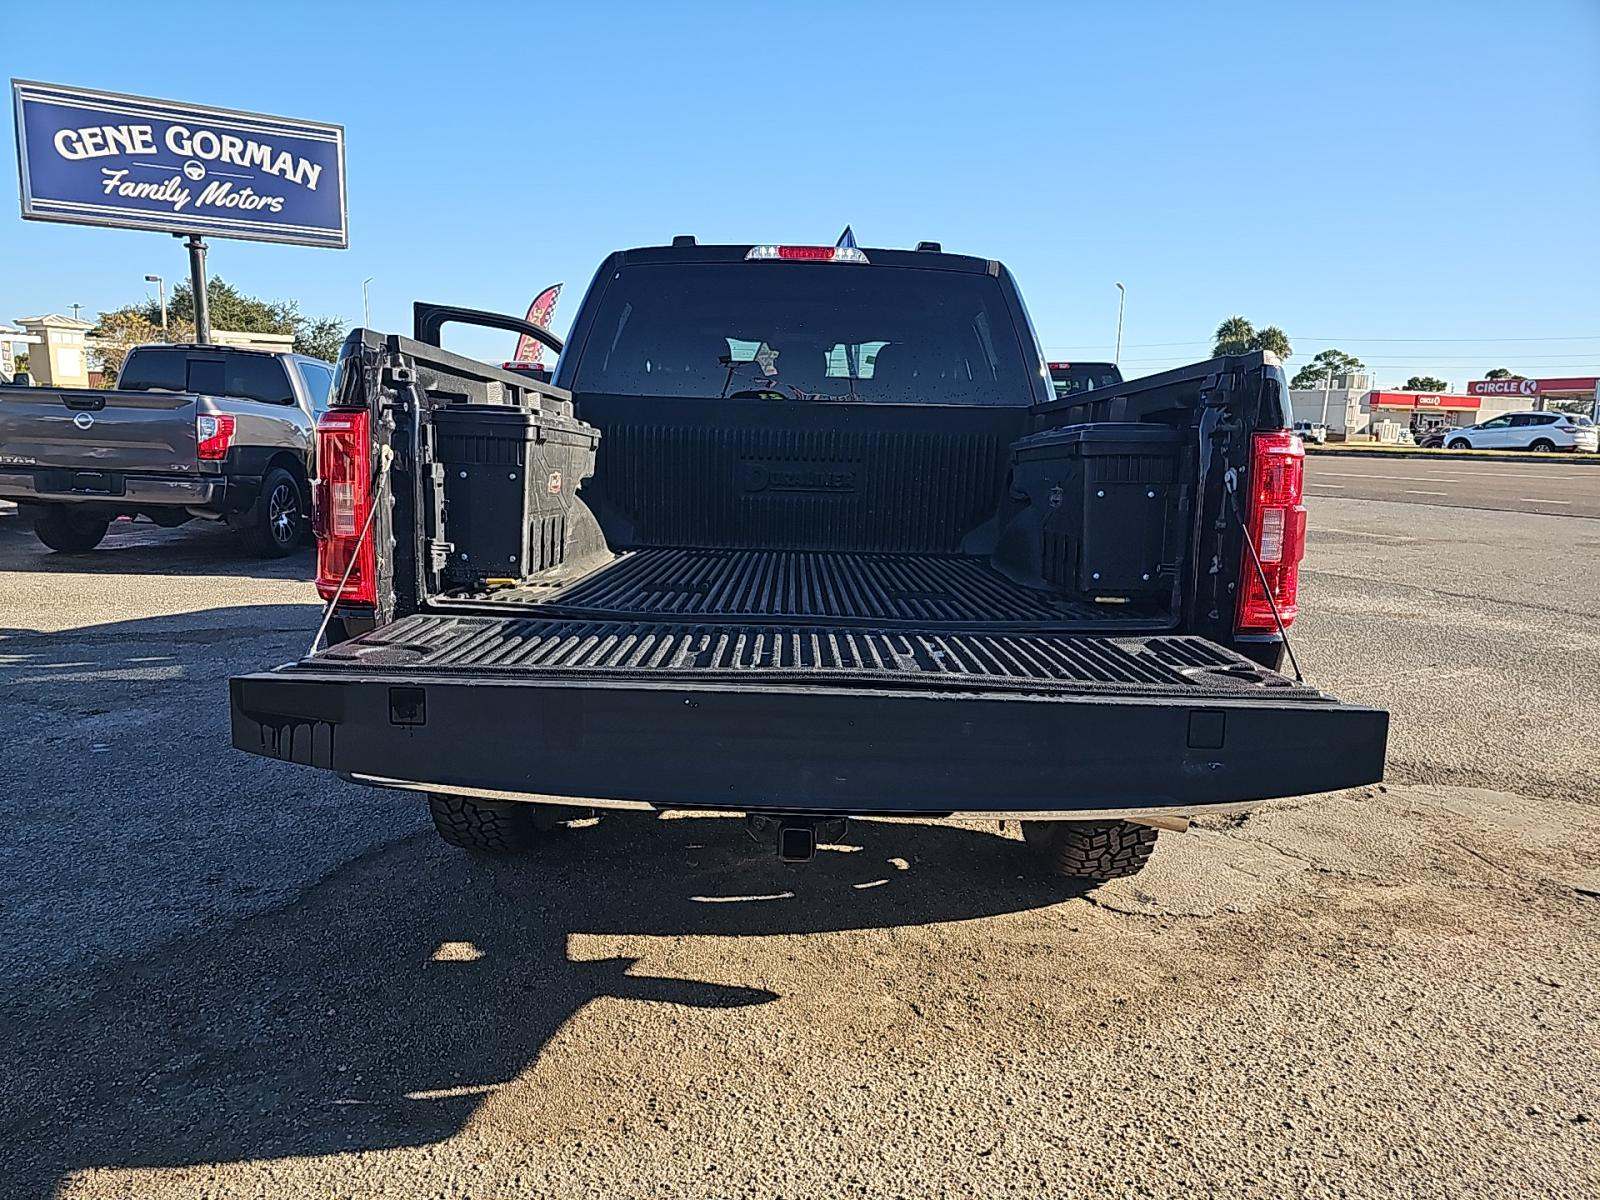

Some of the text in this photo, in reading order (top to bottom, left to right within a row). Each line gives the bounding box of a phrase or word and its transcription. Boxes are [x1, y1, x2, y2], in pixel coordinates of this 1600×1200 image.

[54, 125, 322, 191] GENE GORMAN
[101, 167, 285, 213] Family Motors
[1475, 380, 1537, 395] CIRCLE K
[0, 456, 36, 464] ITAN
